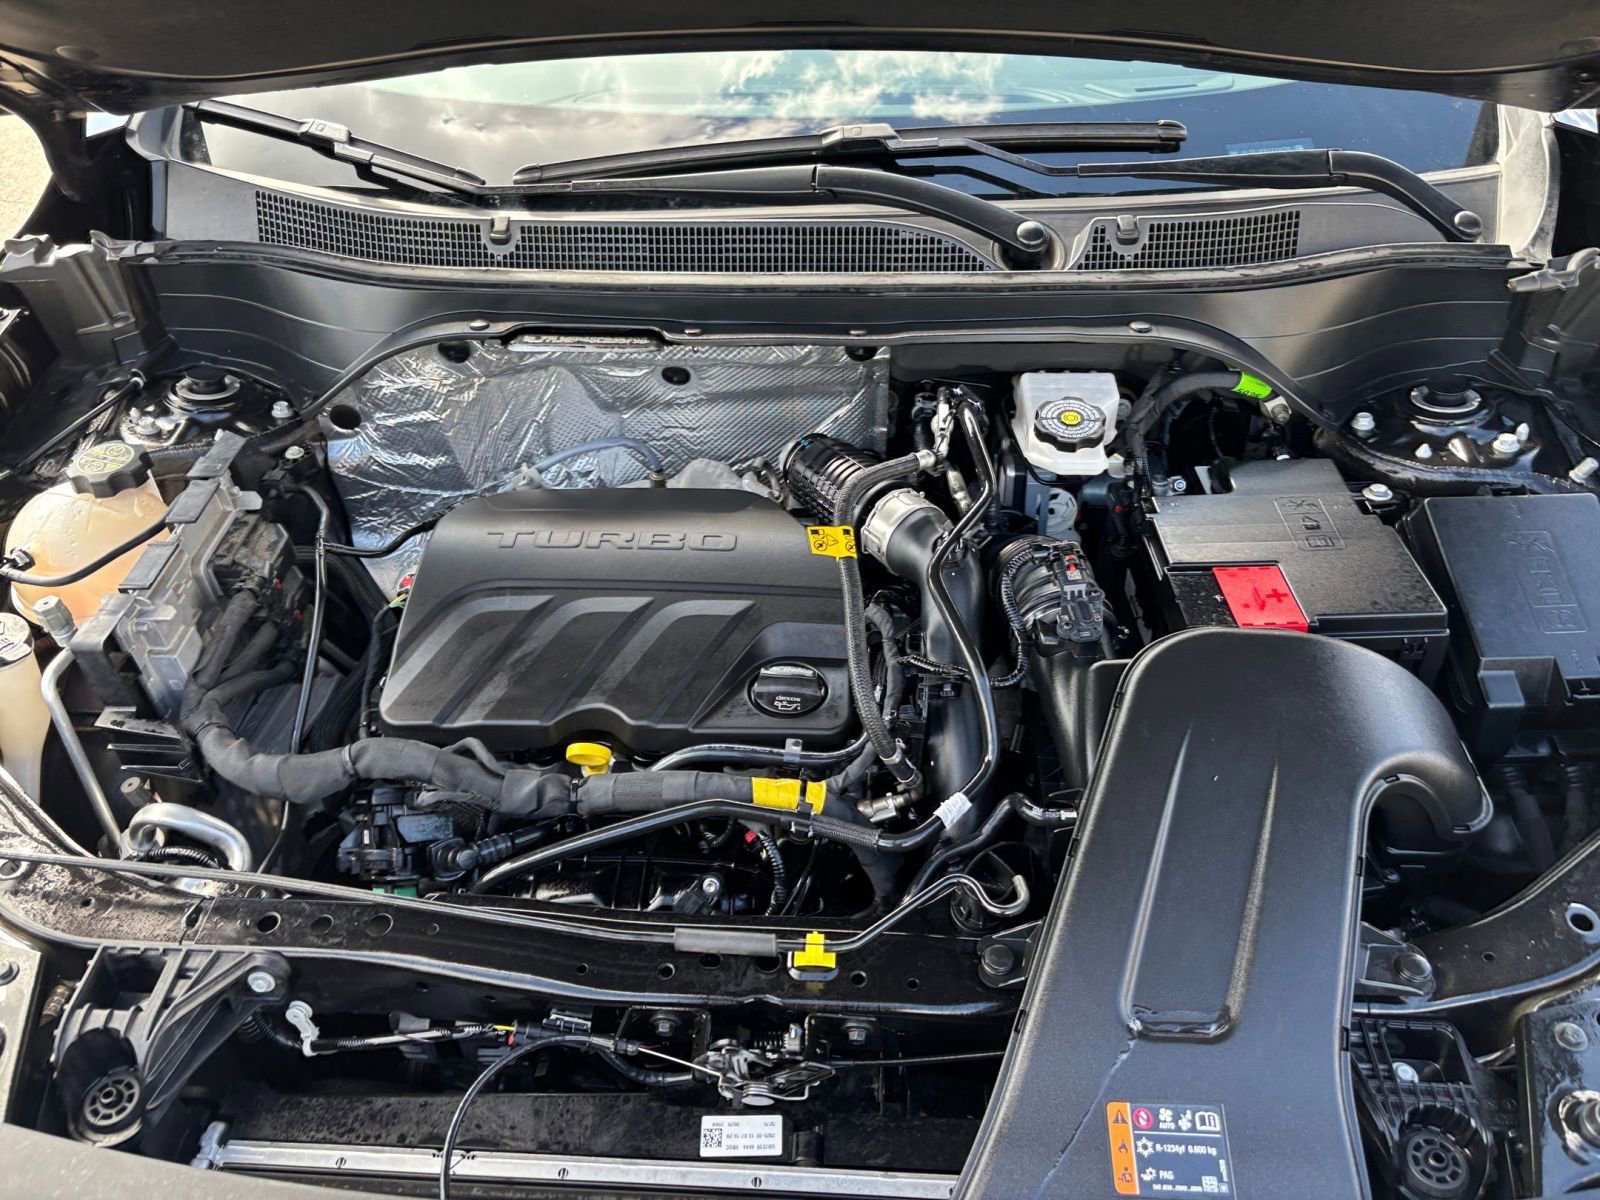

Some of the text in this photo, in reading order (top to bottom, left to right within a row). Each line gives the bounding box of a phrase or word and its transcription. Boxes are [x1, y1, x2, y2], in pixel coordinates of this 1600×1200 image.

[487, 530, 738, 552] TURBO
[1159, 1122, 1176, 1130] AUTO
[1155, 1143, 1186, 1155] R-1234yf
[1207, 1146, 1218, 1157] kg
[1159, 1170, 1175, 1181] PAG
